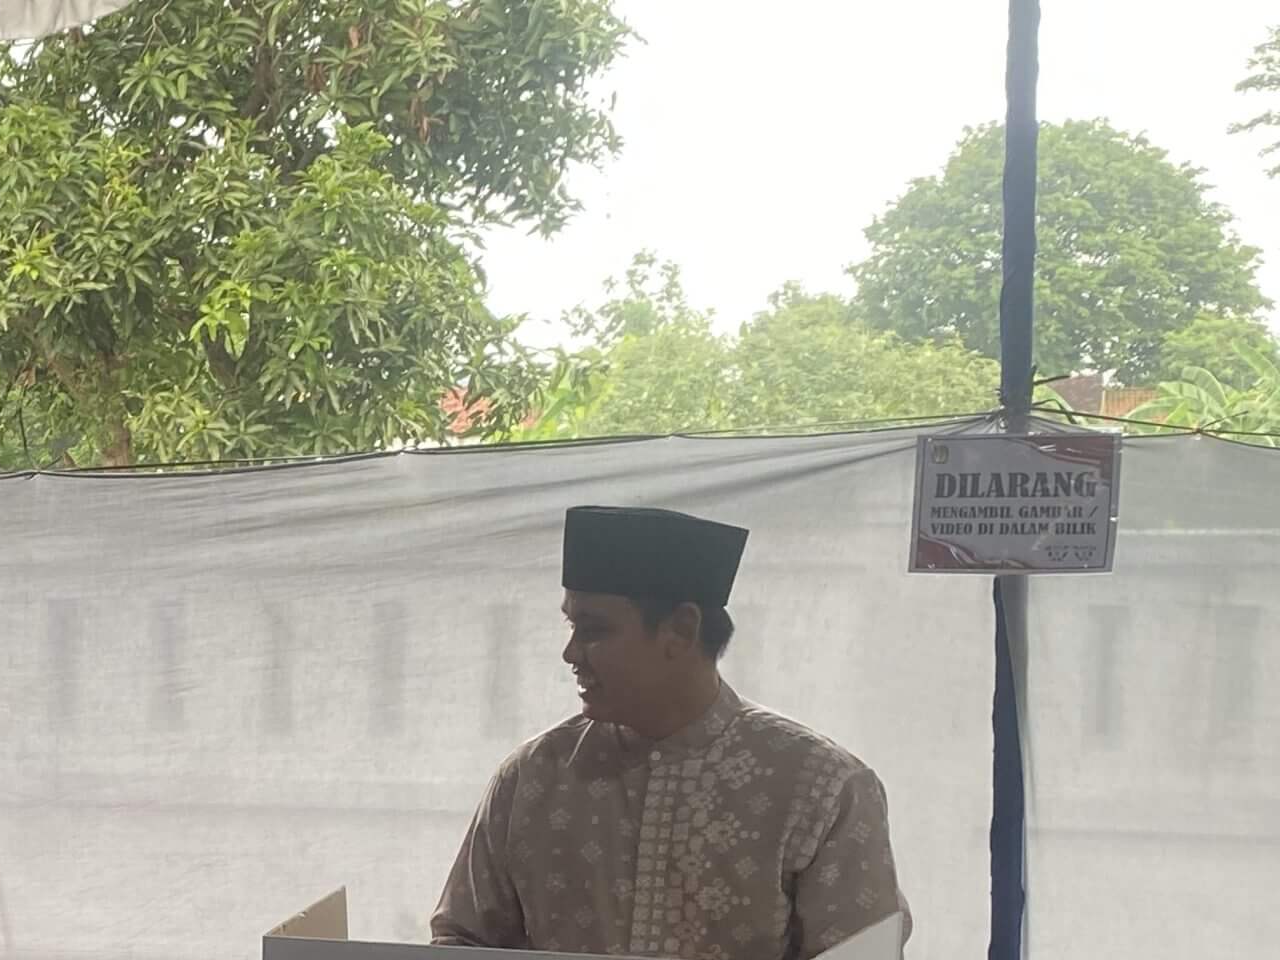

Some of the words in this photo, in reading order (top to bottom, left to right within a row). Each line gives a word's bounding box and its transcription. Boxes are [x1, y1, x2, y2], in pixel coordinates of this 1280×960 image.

[934, 472, 1097, 498] DILARANG
[930, 505, 1013, 519] MENGAMBIL
[930, 522, 973, 535] VIDEO
[977, 523, 994, 535] DI
[998, 522, 1049, 535] DALAM
[1055, 522, 1096, 535] BILIK
